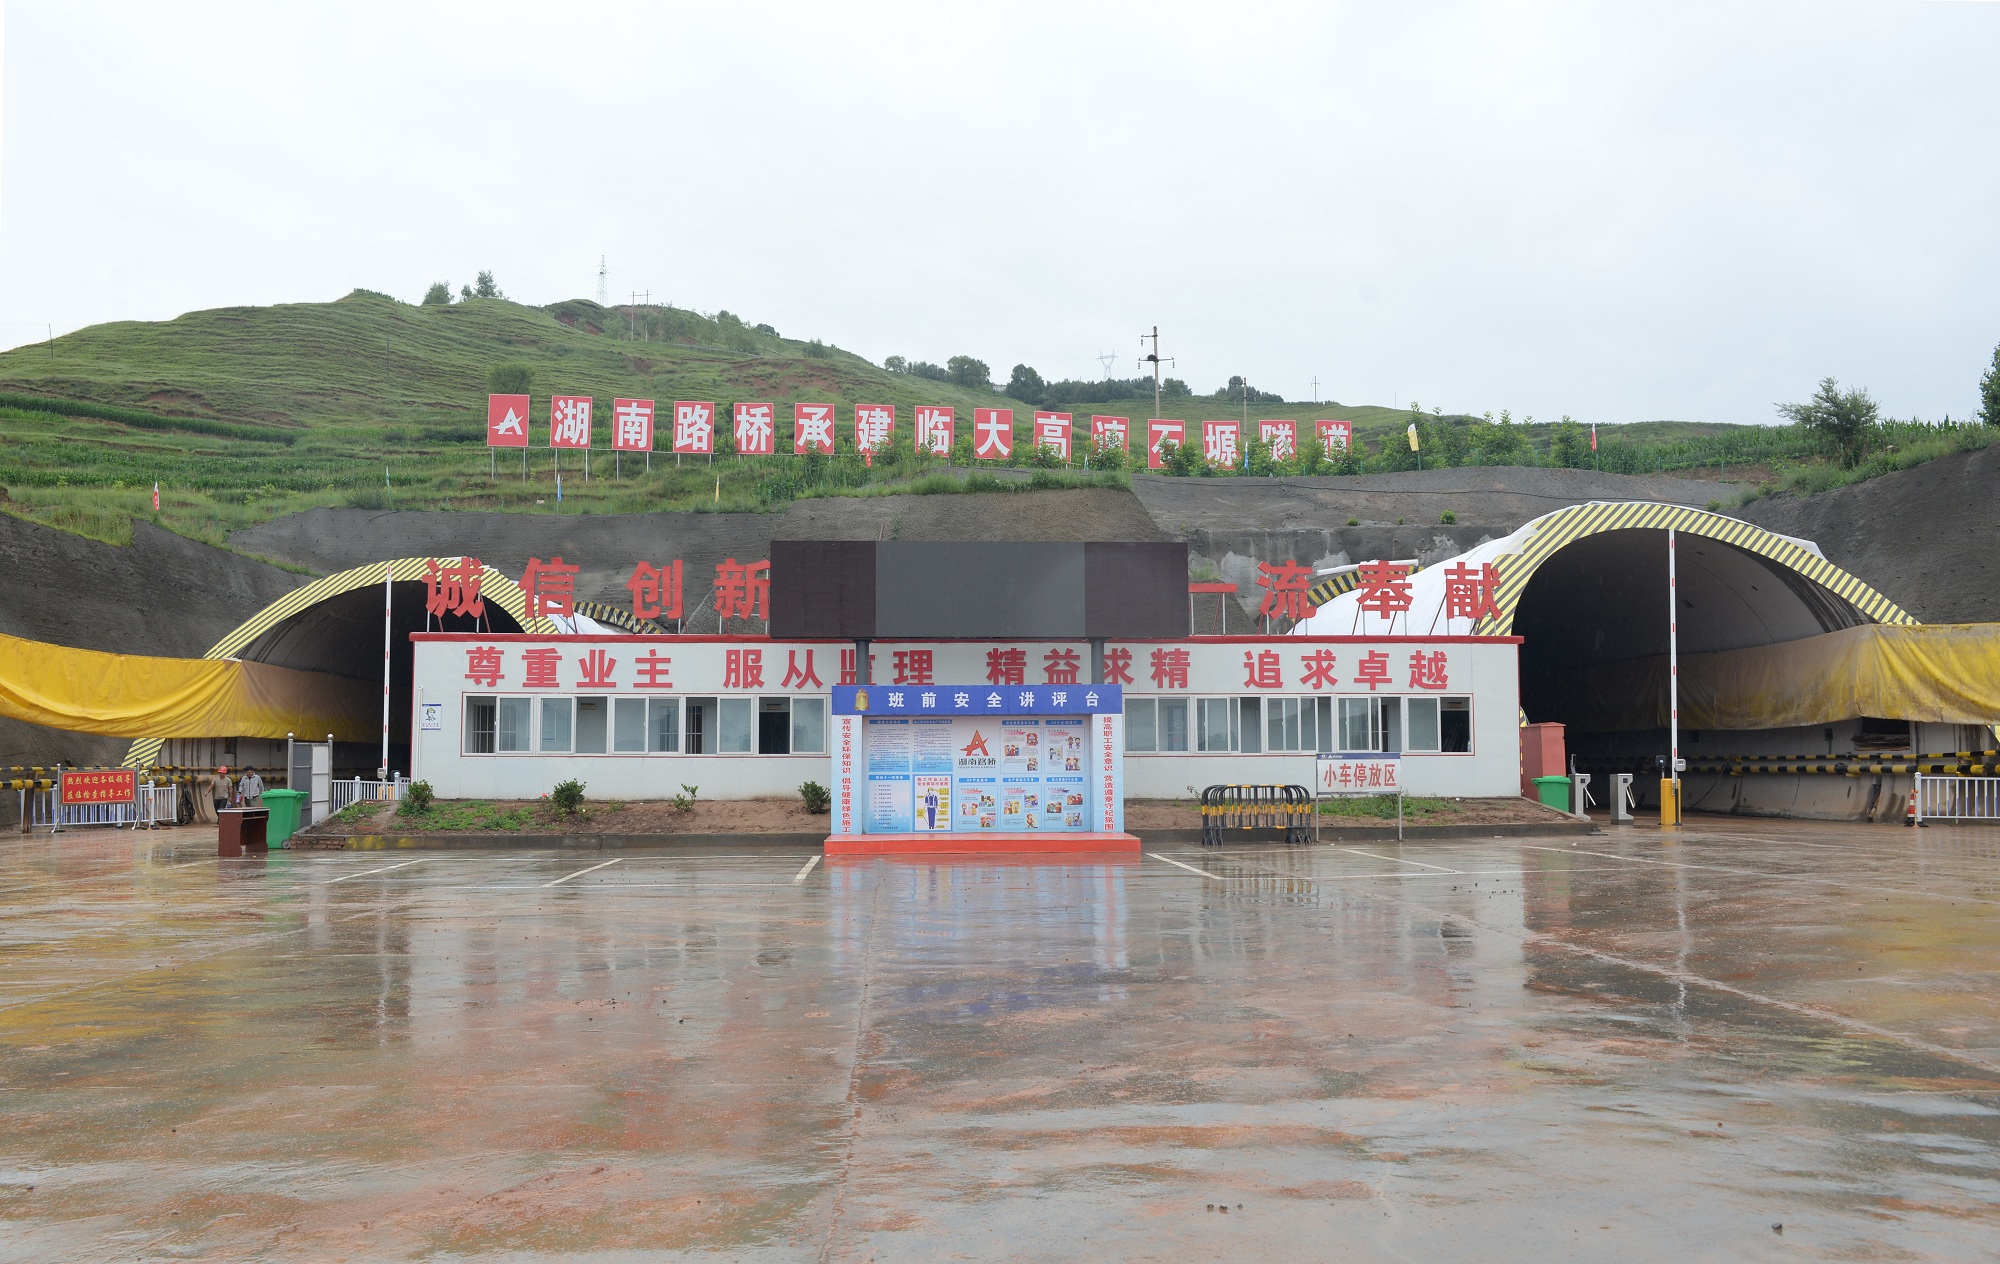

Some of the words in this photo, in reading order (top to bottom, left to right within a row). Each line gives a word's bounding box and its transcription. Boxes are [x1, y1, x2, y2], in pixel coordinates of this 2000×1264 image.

[422, 556, 771, 620] 诚信创新
[465, 646, 674, 687] 尊重业主
[723, 648, 935, 688] 服从监理
[986, 647, 1191, 689] 精益求精
[1243, 648, 1450, 690] 追求卓越
[888, 691, 1100, 708] 班前安全讲评台
[842, 718, 851, 773] 宣传安全环保知识
[1103, 717, 1113, 771] 提高职工安全意识
[66, 774, 131, 785] 热烈欢迎各级领导
[1323, 763, 1396, 787] 小车停放区
[66, 789, 131, 800] 莅临检查指导工作
